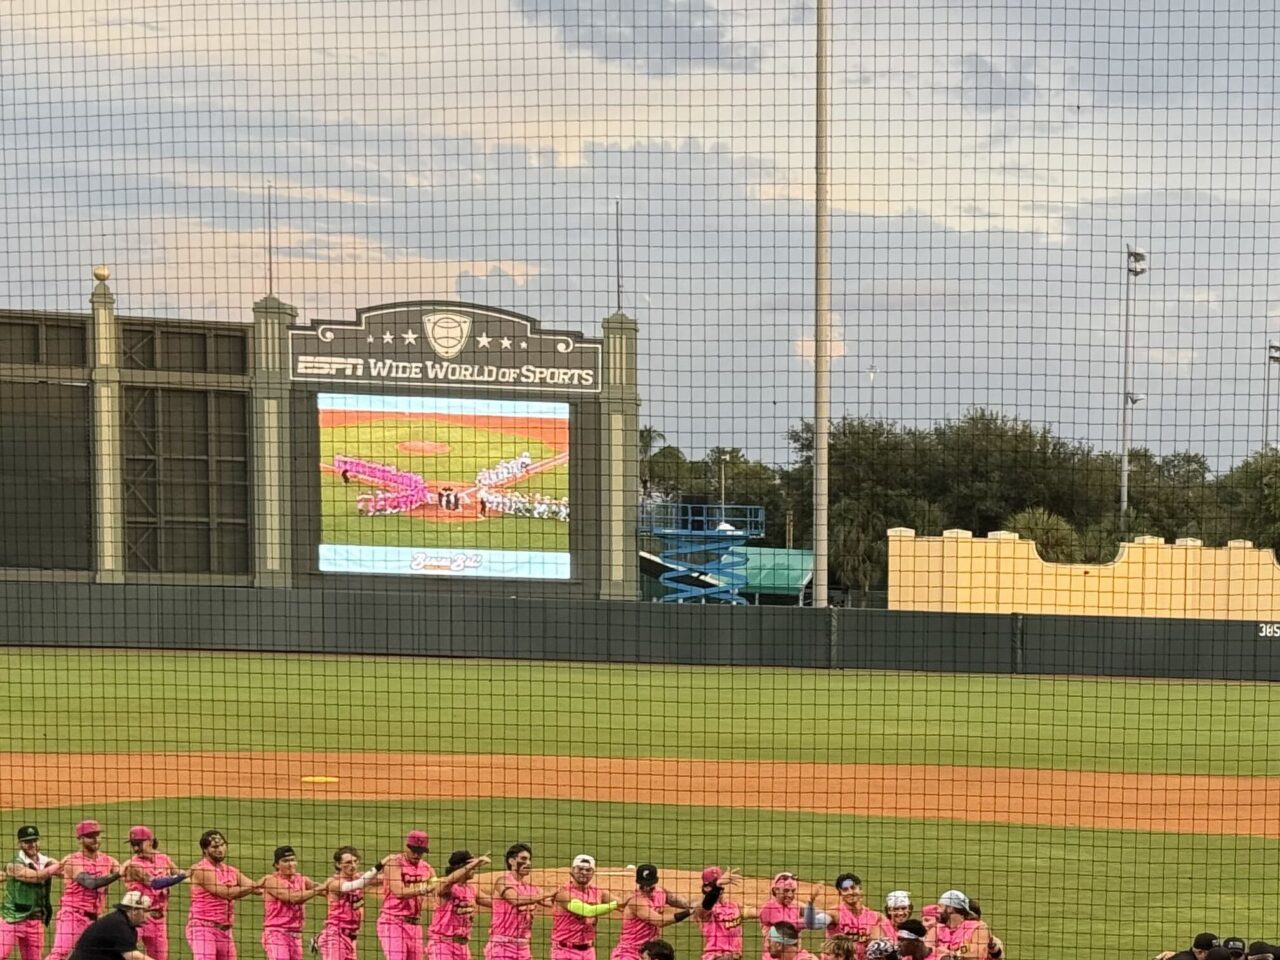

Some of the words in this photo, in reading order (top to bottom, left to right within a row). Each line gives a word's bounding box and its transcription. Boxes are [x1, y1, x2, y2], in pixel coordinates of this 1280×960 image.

[297, 356, 364, 376] ESPN
[368, 358, 423, 379] WIDE
[425, 360, 497, 382] WORLD
[498, 367, 519, 382] OF
[521, 364, 594, 386] SPORTS
[1258, 623, 1280, 637] 385
